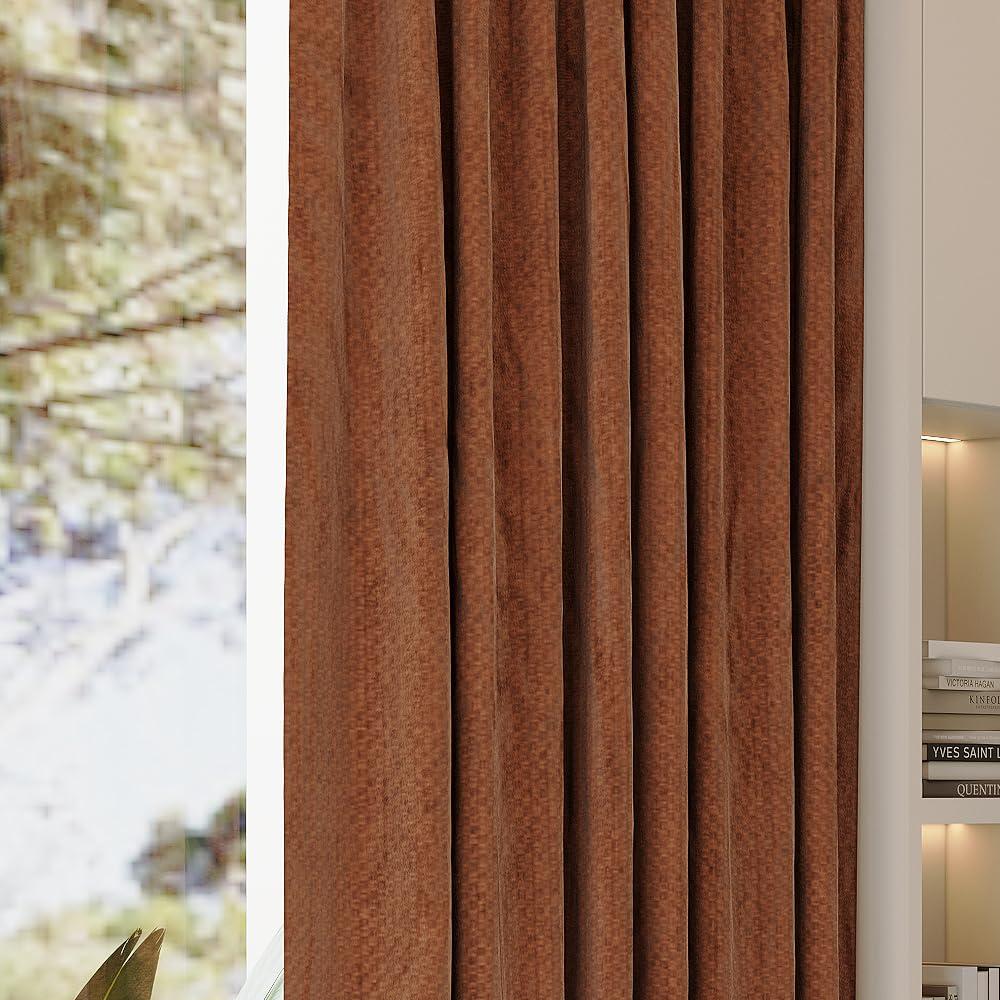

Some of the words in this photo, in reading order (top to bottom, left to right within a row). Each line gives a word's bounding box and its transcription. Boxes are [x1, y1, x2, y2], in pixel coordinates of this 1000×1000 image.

[946, 678, 974, 688] VICTORIA
[974, 680, 995, 689] HAGAN
[932, 746, 960, 759] YVES
[963, 746, 994, 759] SAINT
